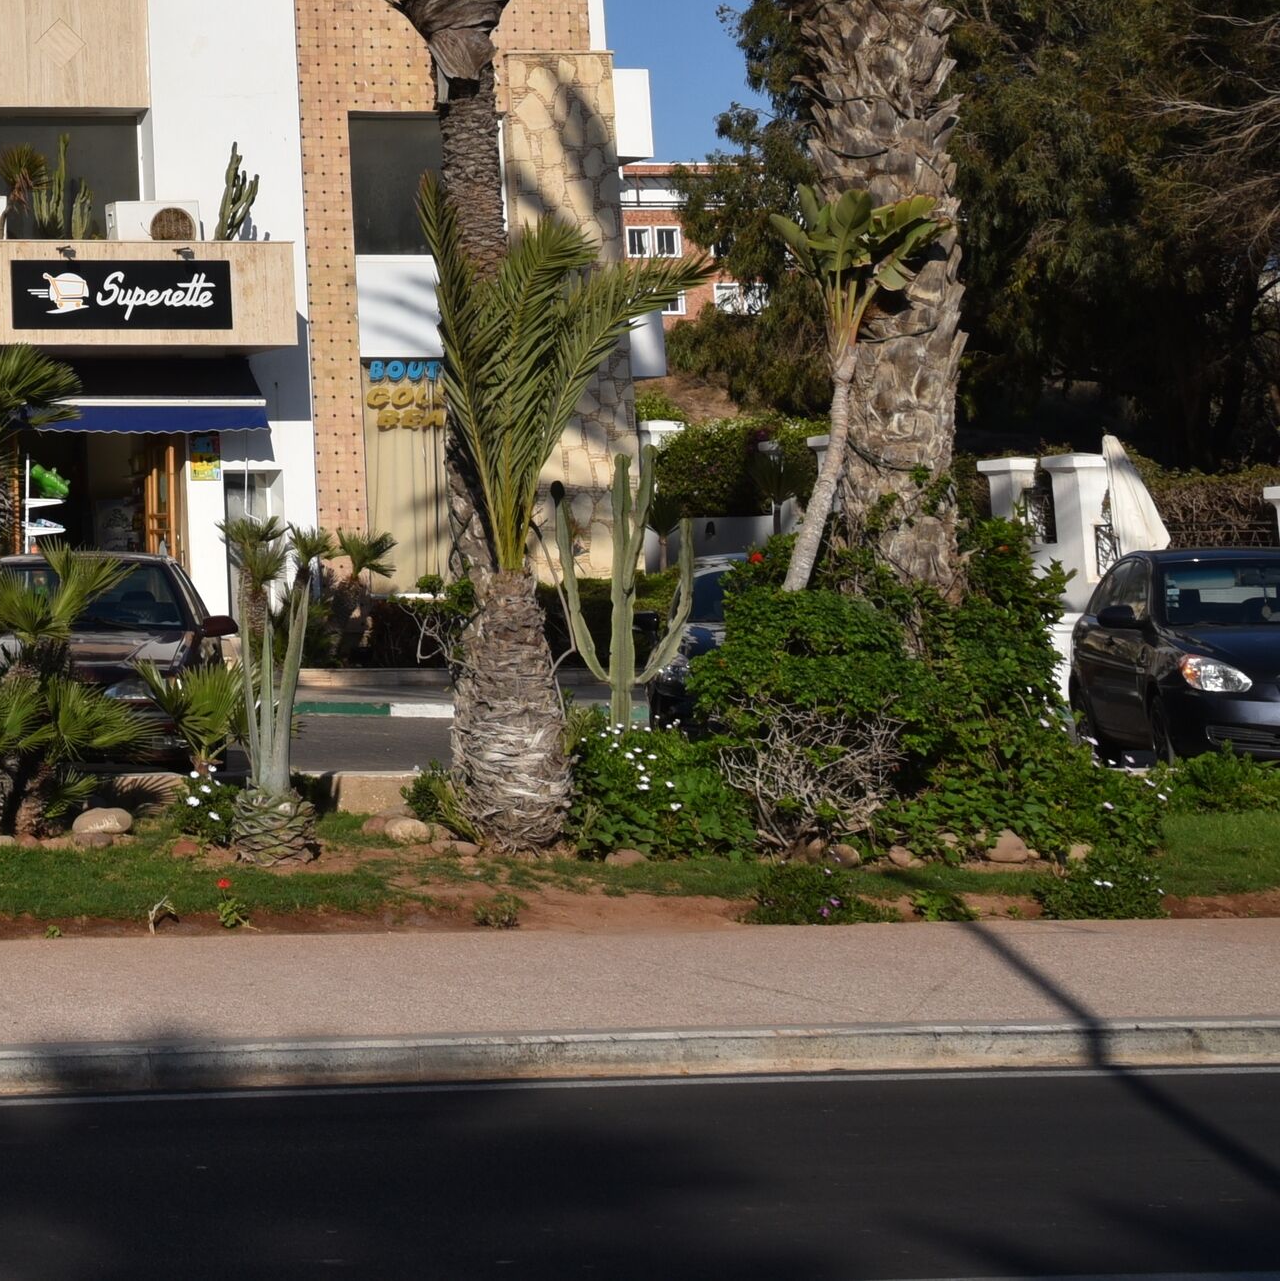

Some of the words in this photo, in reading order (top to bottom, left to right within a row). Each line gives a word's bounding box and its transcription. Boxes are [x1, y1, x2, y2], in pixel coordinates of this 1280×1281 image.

[96, 271, 216, 320] Superette
[369, 360, 441, 383] BOUT
[377, 409, 444, 432] BEA
